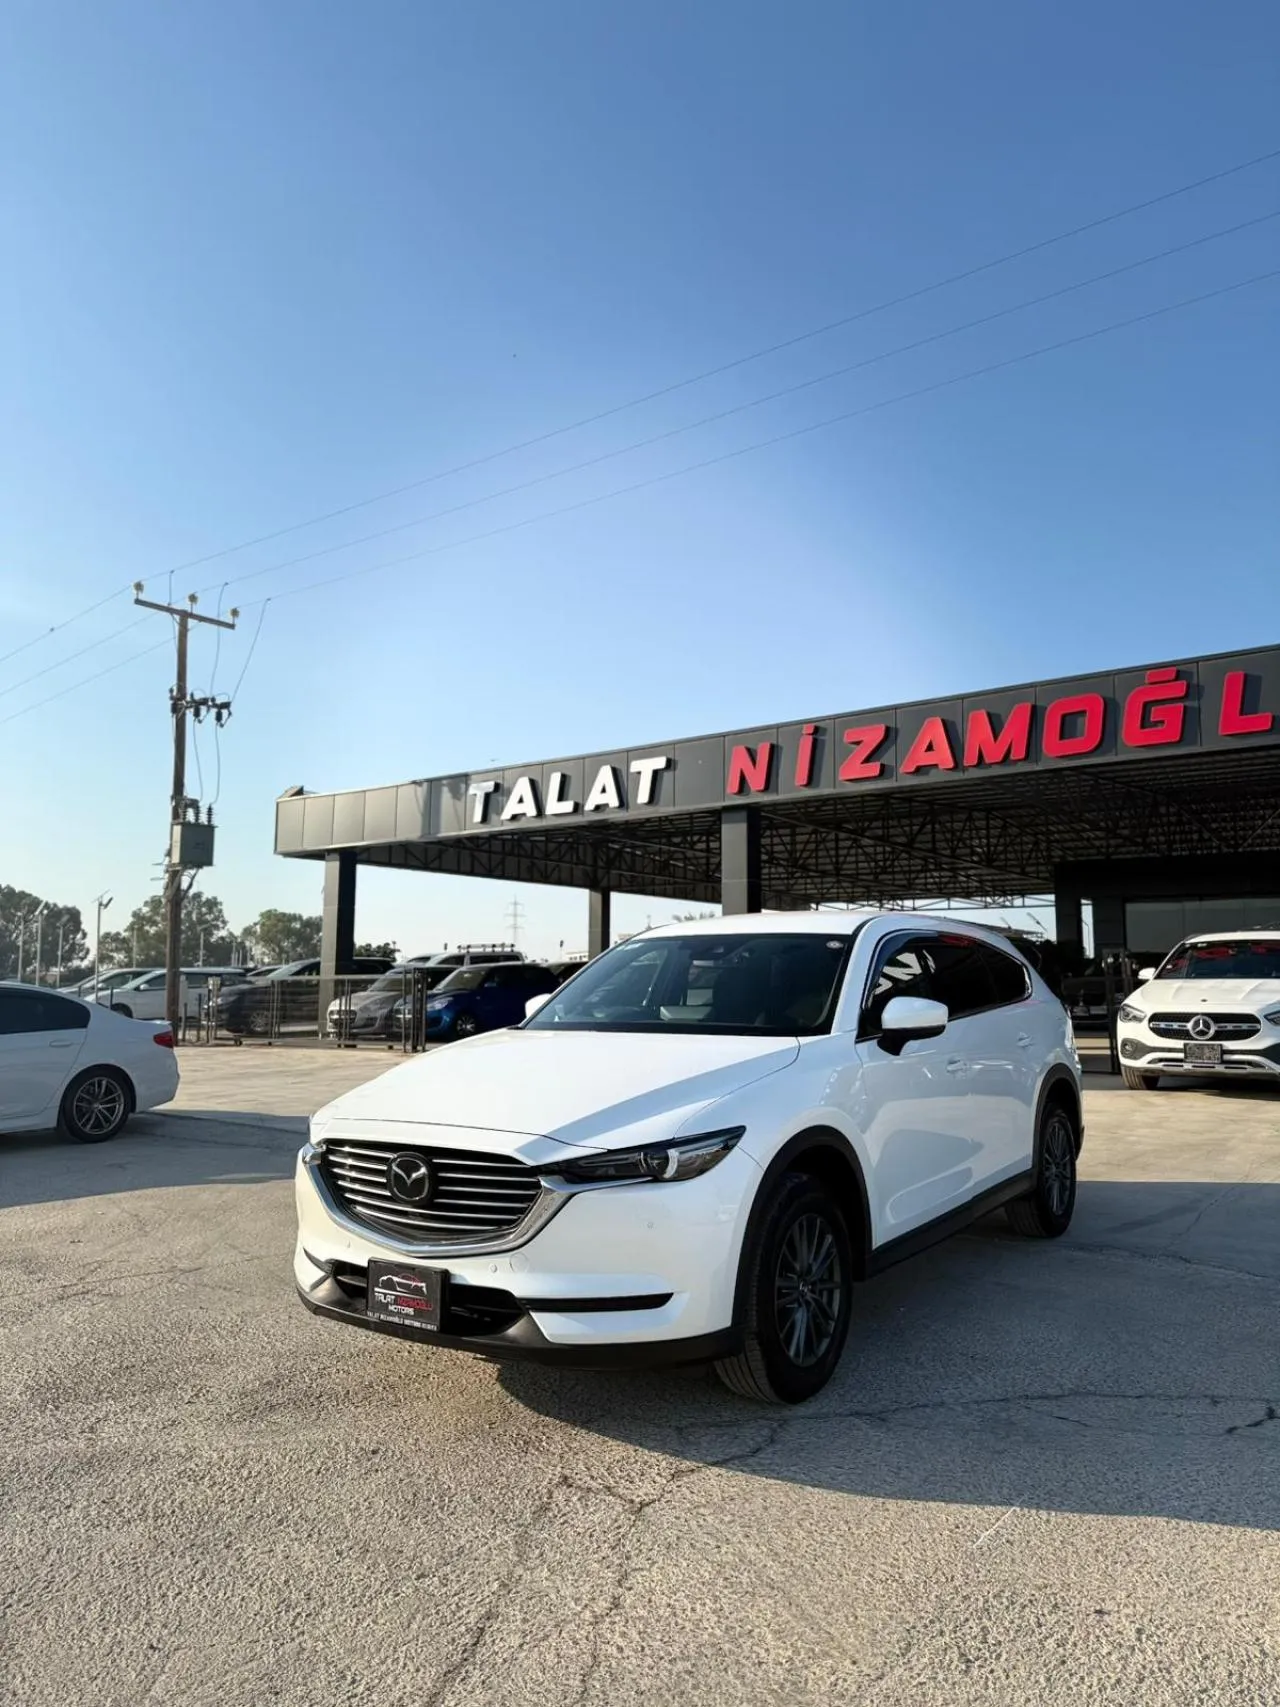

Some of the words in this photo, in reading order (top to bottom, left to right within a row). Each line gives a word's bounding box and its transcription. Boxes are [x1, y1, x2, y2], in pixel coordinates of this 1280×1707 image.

[468, 756, 668, 824] TALAT
[374, 1292, 395, 1303] TALAT
[388, 1305, 414, 1315] MOTORS
